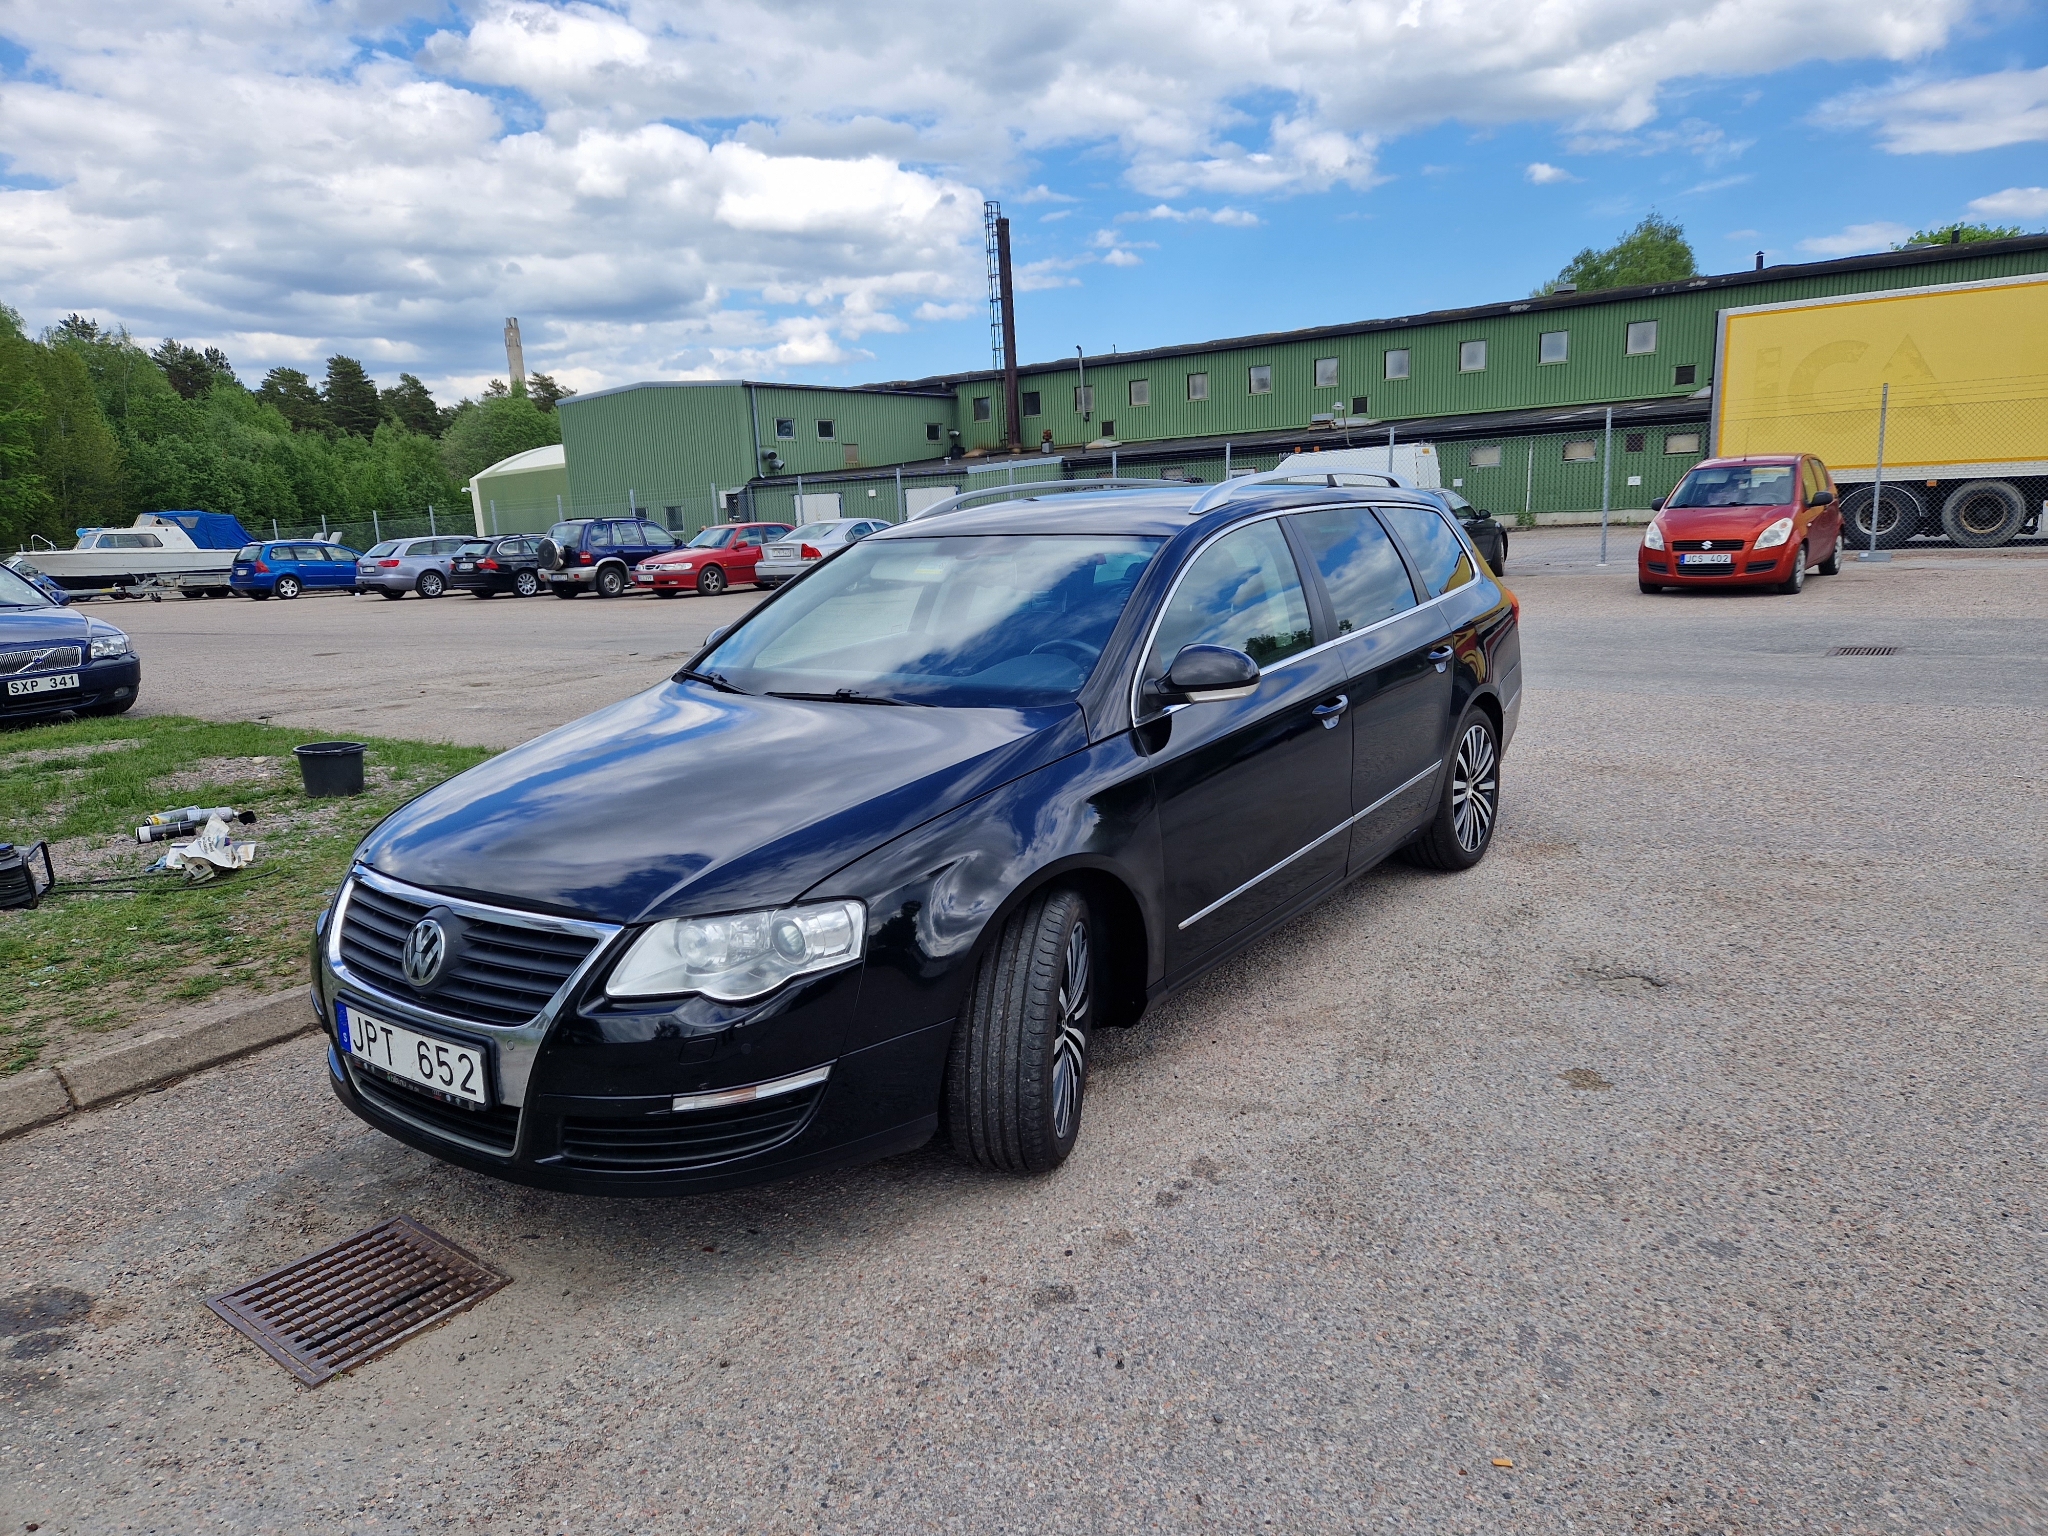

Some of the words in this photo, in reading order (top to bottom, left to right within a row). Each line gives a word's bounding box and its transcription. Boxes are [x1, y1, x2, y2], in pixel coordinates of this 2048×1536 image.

[1752, 333, 1963, 435] ICA
[1686, 555, 1703, 563] JCS
[1711, 554, 1729, 563] 402
[10, 680, 38, 694] SXP
[49, 675, 75, 689] 341
[353, 1016, 393, 1067] JPT
[416, 1040, 477, 1096] 652
